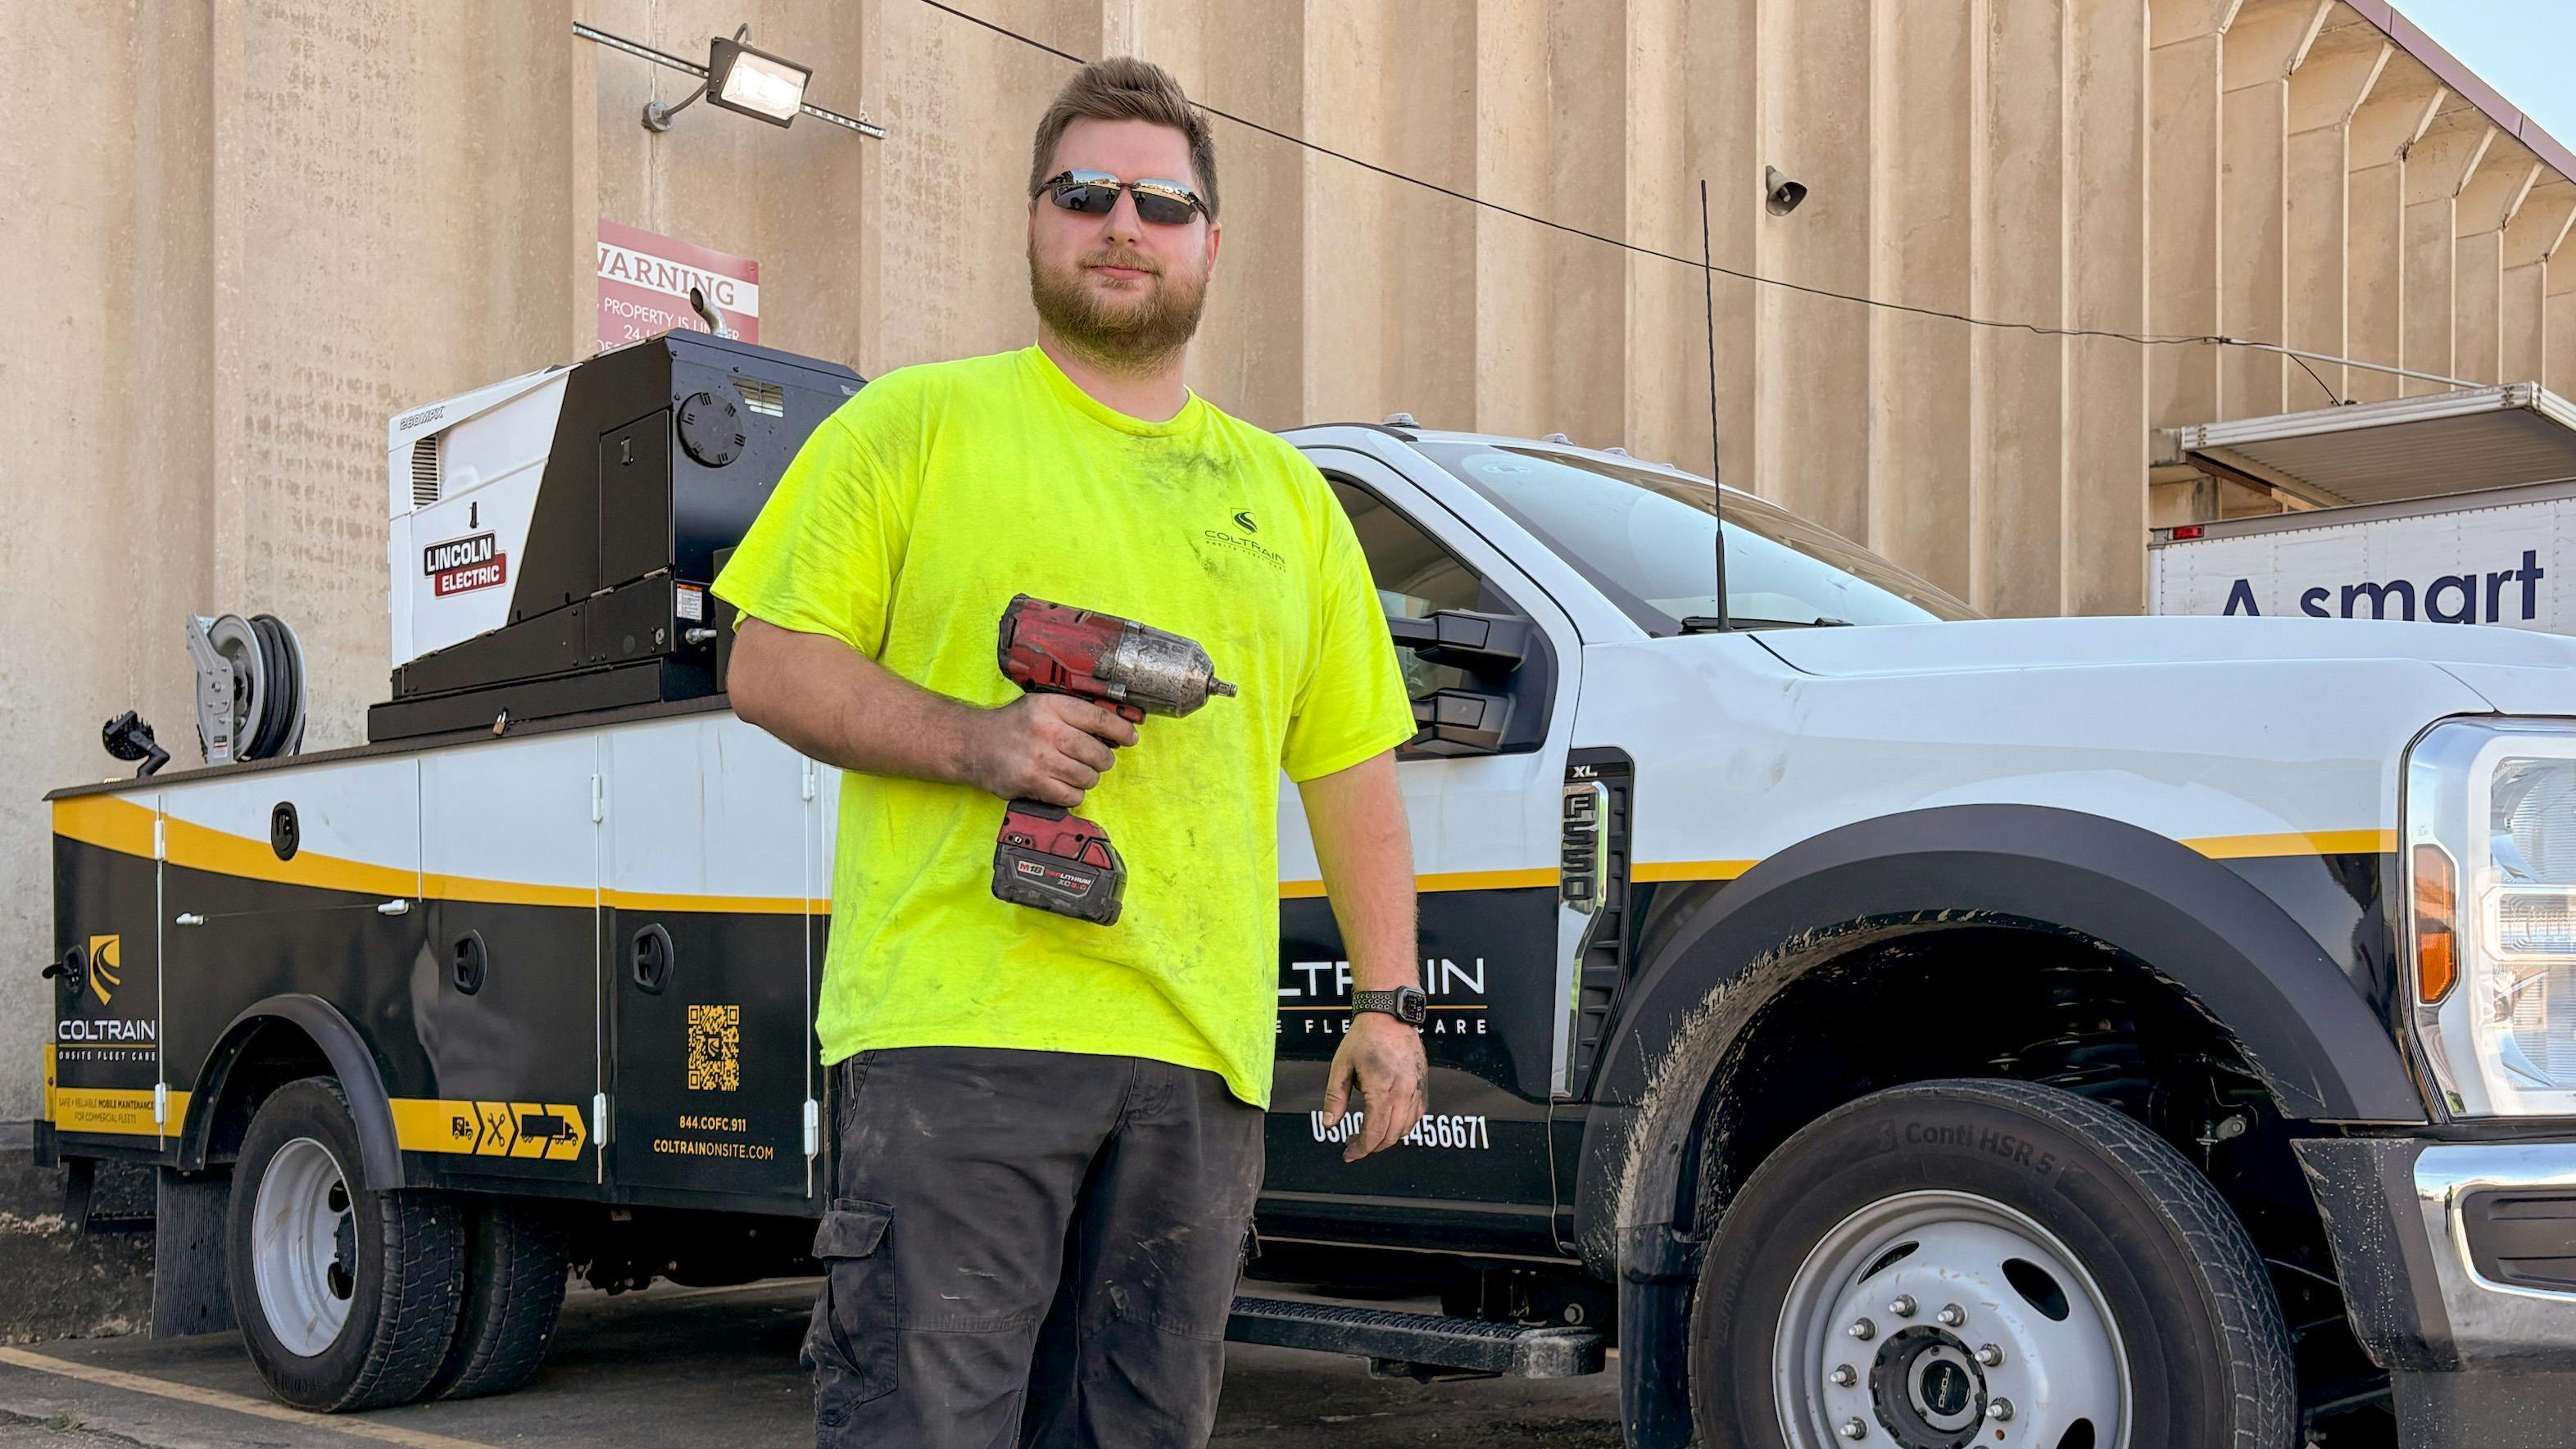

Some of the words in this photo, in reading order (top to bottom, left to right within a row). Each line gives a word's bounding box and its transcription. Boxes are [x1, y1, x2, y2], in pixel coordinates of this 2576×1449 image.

[605, 297, 674, 328] PROPERTY
[678, 316, 689, 329] IS
[427, 537, 492, 573] LINCOLN
[1205, 530, 1285, 564] COLTRAIN
[442, 565, 500, 592] ELECTRIC
[2300, 550, 2544, 625] smart
[1572, 765, 1598, 778] XL
[1019, 863, 1043, 874] M18
[1058, 879, 1071, 887] XC
[58, 1020, 155, 1040] COLTRAIN
[98, 1051, 125, 1061] FLEET
[132, 1052, 156, 1062] CARE
[679, 1116, 746, 1132] 844.COFC.911
[654, 1139, 773, 1160] COLTRAINONSITE.COM
[1905, 1122, 1973, 1146] Conti
[1979, 1127, 2034, 1166] HSR
[1939, 1367, 1951, 1408] FORD
